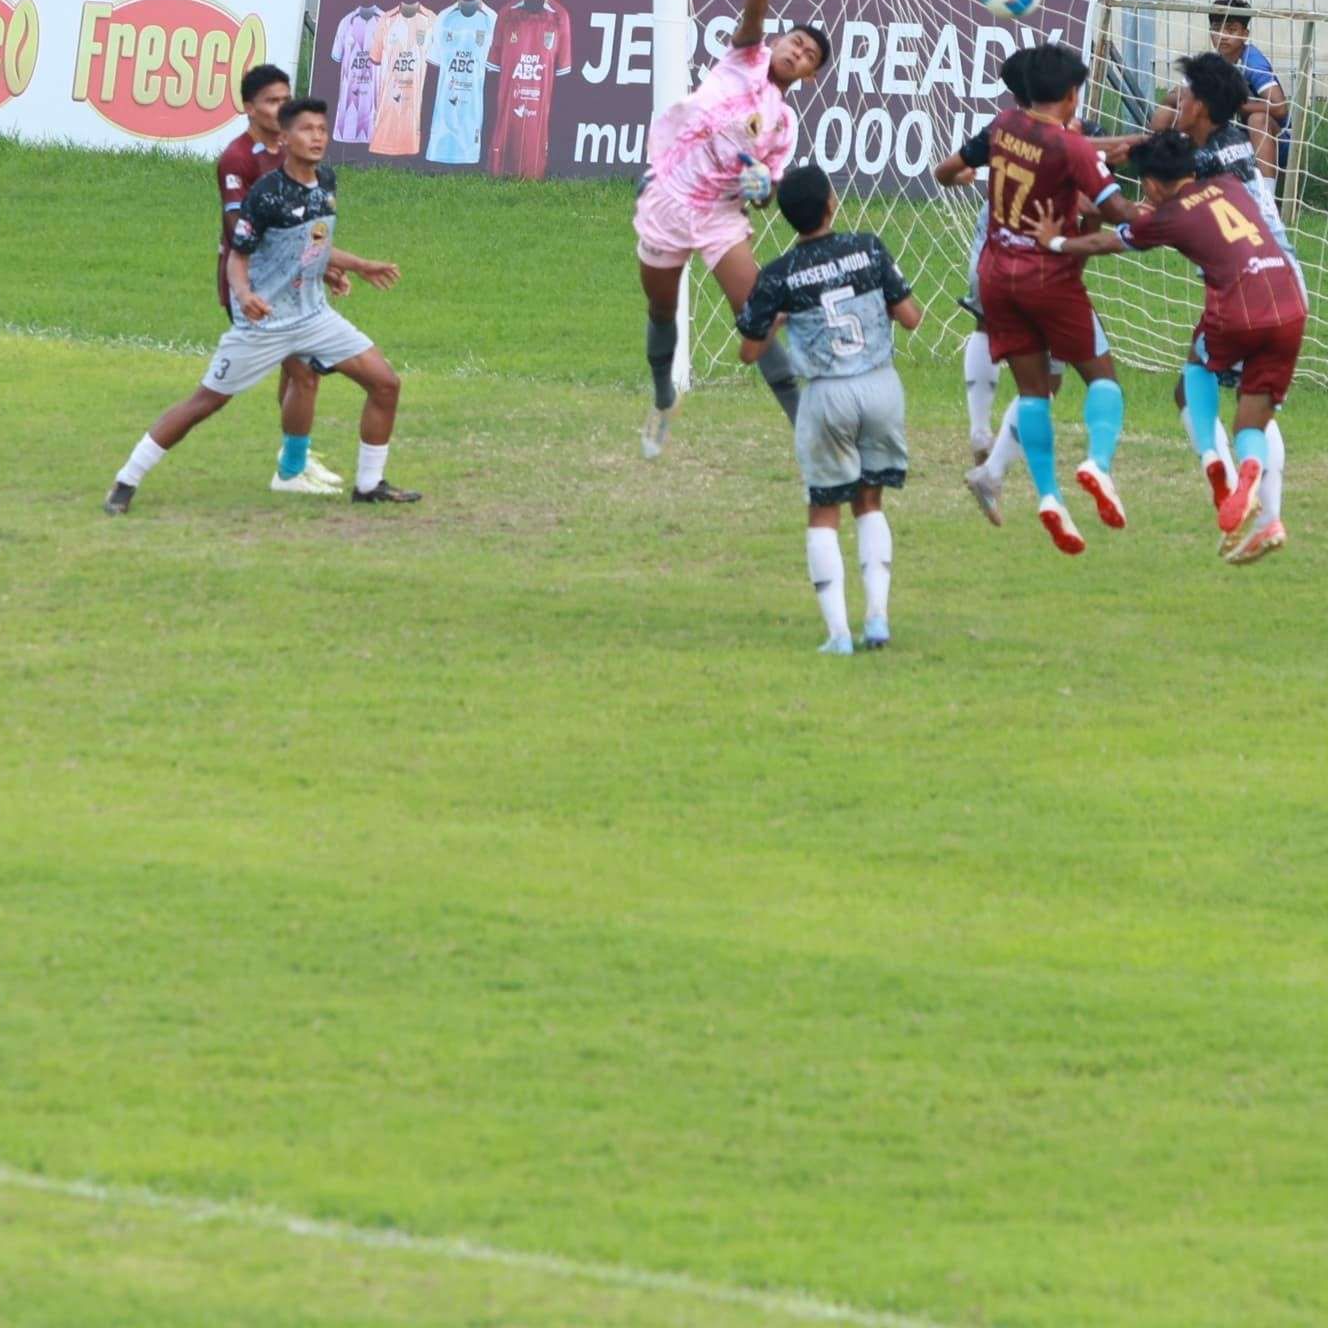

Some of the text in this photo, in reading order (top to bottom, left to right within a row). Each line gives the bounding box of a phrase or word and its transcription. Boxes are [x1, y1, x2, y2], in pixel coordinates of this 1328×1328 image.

[72, 0, 267, 114] Fresco
[351, 57, 371, 70] ABC
[392, 59, 416, 72] ABC
[448, 58, 475, 73] ABC
[520, 53, 540, 64] KOPI
[512, 63, 545, 81] ABC
[990, 156, 1036, 230] 17
[1208, 197, 1265, 247] 4
[839, 251, 871, 273] MUDA
[819, 285, 866, 357] 5
[214, 357, 231, 380] 3
